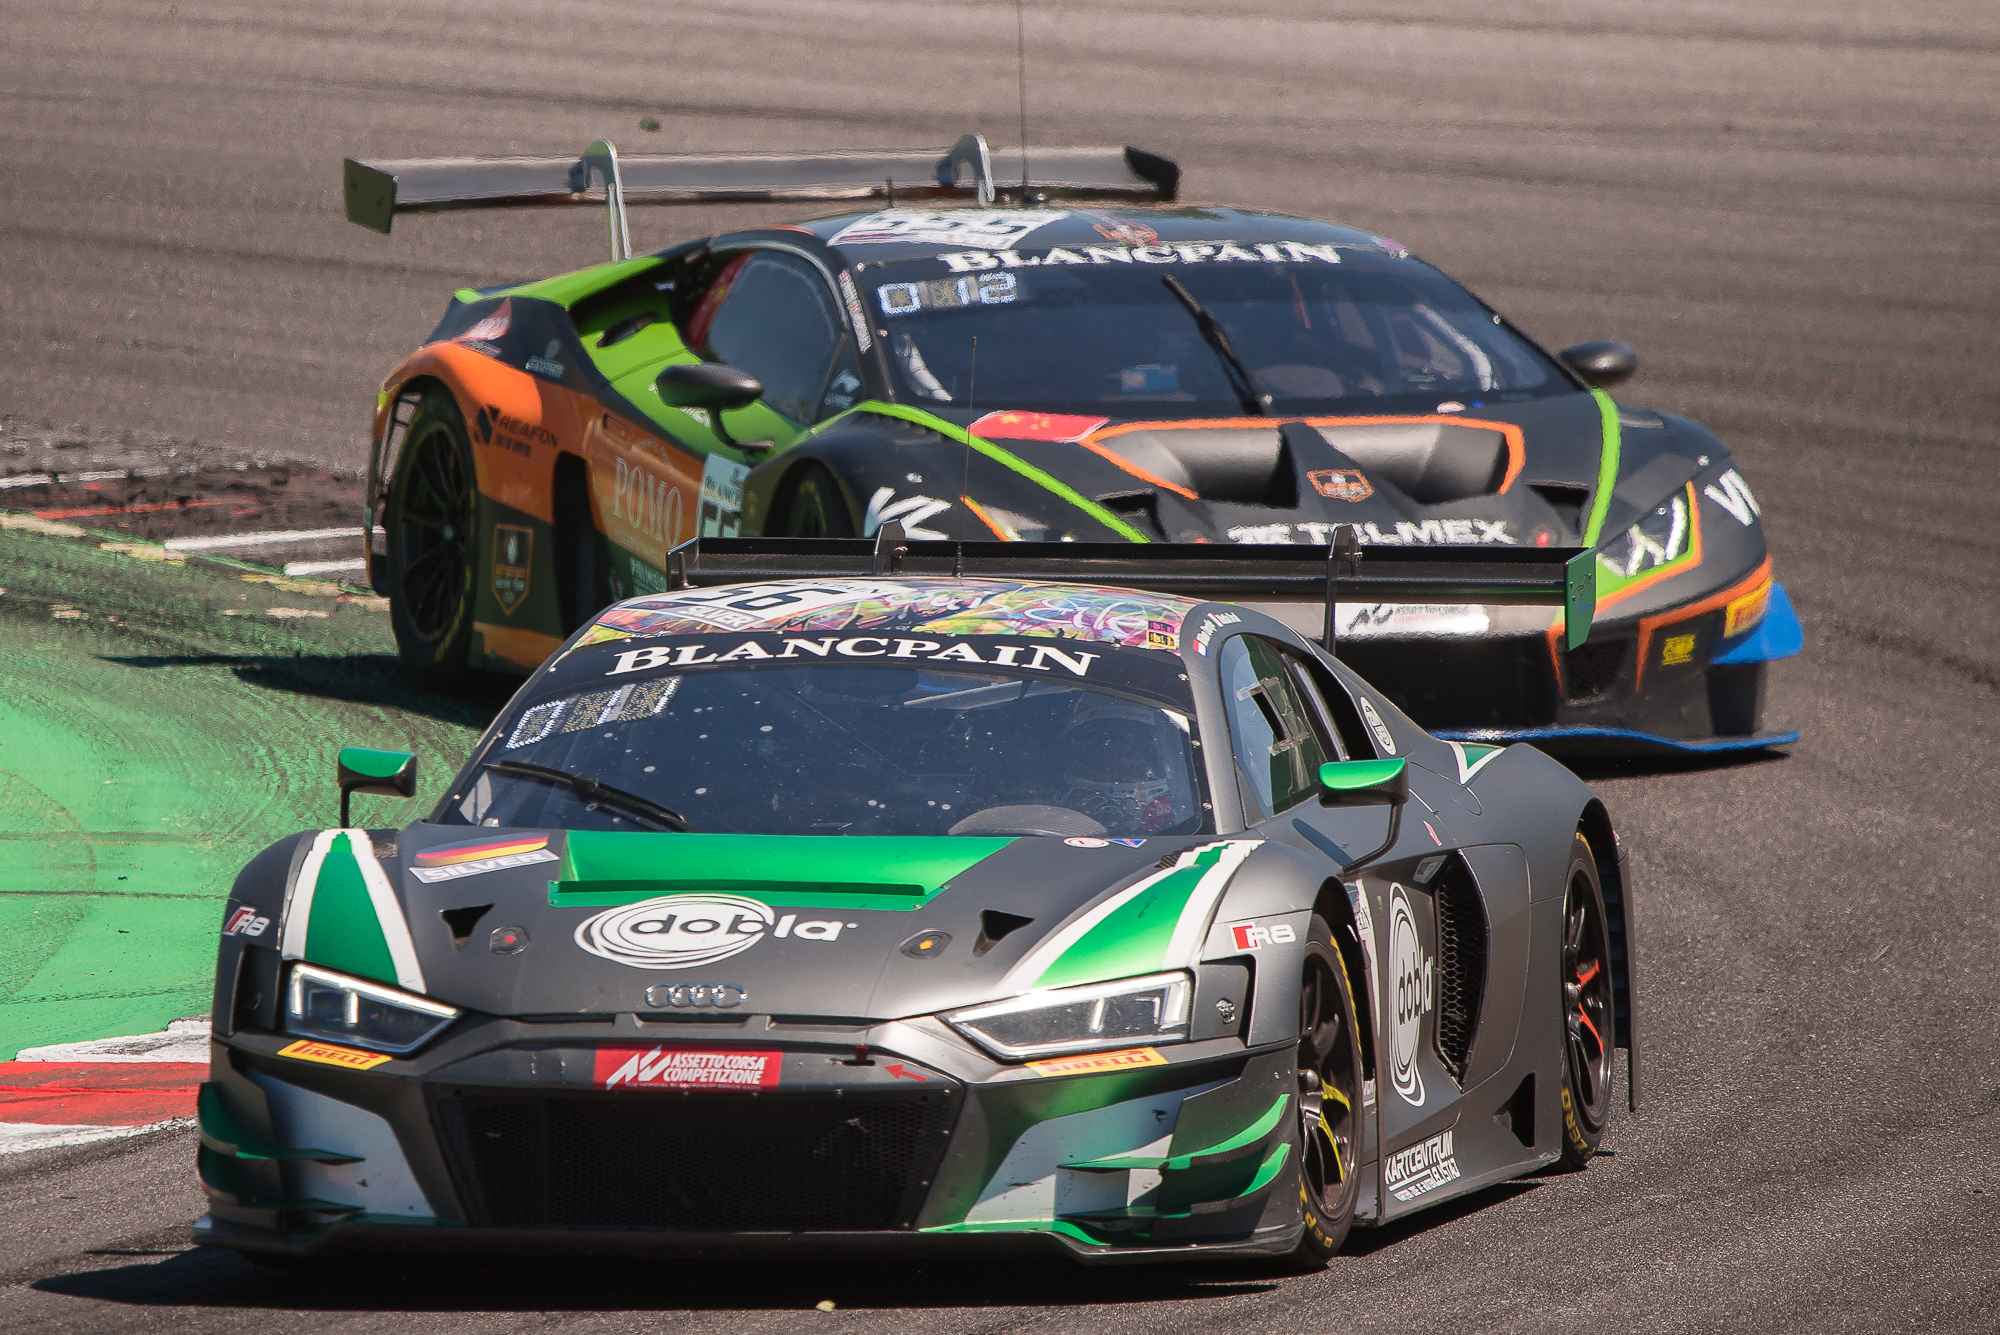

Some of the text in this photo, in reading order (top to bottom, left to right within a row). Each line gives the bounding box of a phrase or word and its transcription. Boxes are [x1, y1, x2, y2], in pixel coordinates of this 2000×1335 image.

[936, 241, 1342, 273] BLANCPAIN
[613, 456, 684, 549] POMO
[676, 583, 848, 611] 56
[681, 604, 749, 628] SILVER
[605, 637, 1101, 676] BLANCPAIN
[423, 852, 547, 880] SILVER
[226, 909, 270, 937] R8
[629, 914, 844, 942] dobla
[1237, 923, 1297, 948] R8
[1398, 945, 1433, 1026] dobla
[291, 1041, 381, 1066] PIRELLI
[1039, 1050, 1152, 1073] PIRELLI
[662, 1068, 763, 1085] COMPETIZIONE
[1385, 1130, 1454, 1185] KARTCENTRUM
